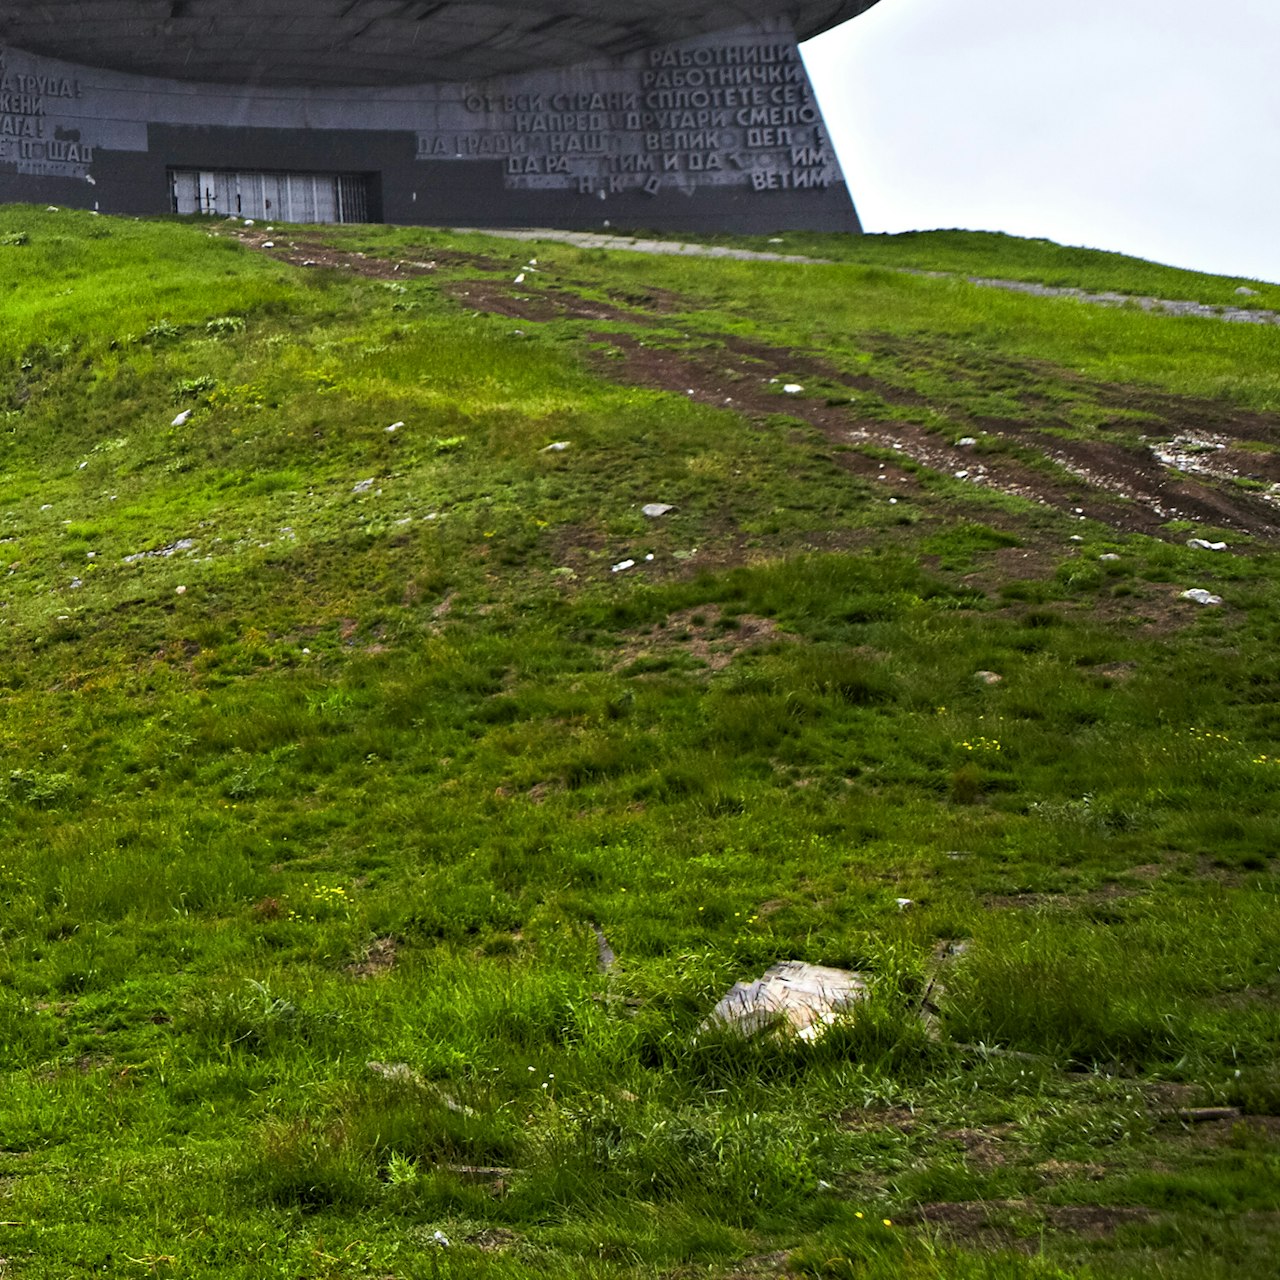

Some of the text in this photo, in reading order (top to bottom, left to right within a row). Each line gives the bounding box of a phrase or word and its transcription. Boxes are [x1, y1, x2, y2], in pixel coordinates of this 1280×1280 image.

[649, 46, 795, 68] РАБОТНИЦИ
[641, 66, 802, 89] РАБОТНИЧКИ
[503, 93, 543, 114] ВСИ
[550, 90, 639, 113] СТРАНИ
[516, 111, 603, 133] НАПРЕД
[627, 110, 726, 130] ДРУГАРИ
[663, 151, 679, 171] И
